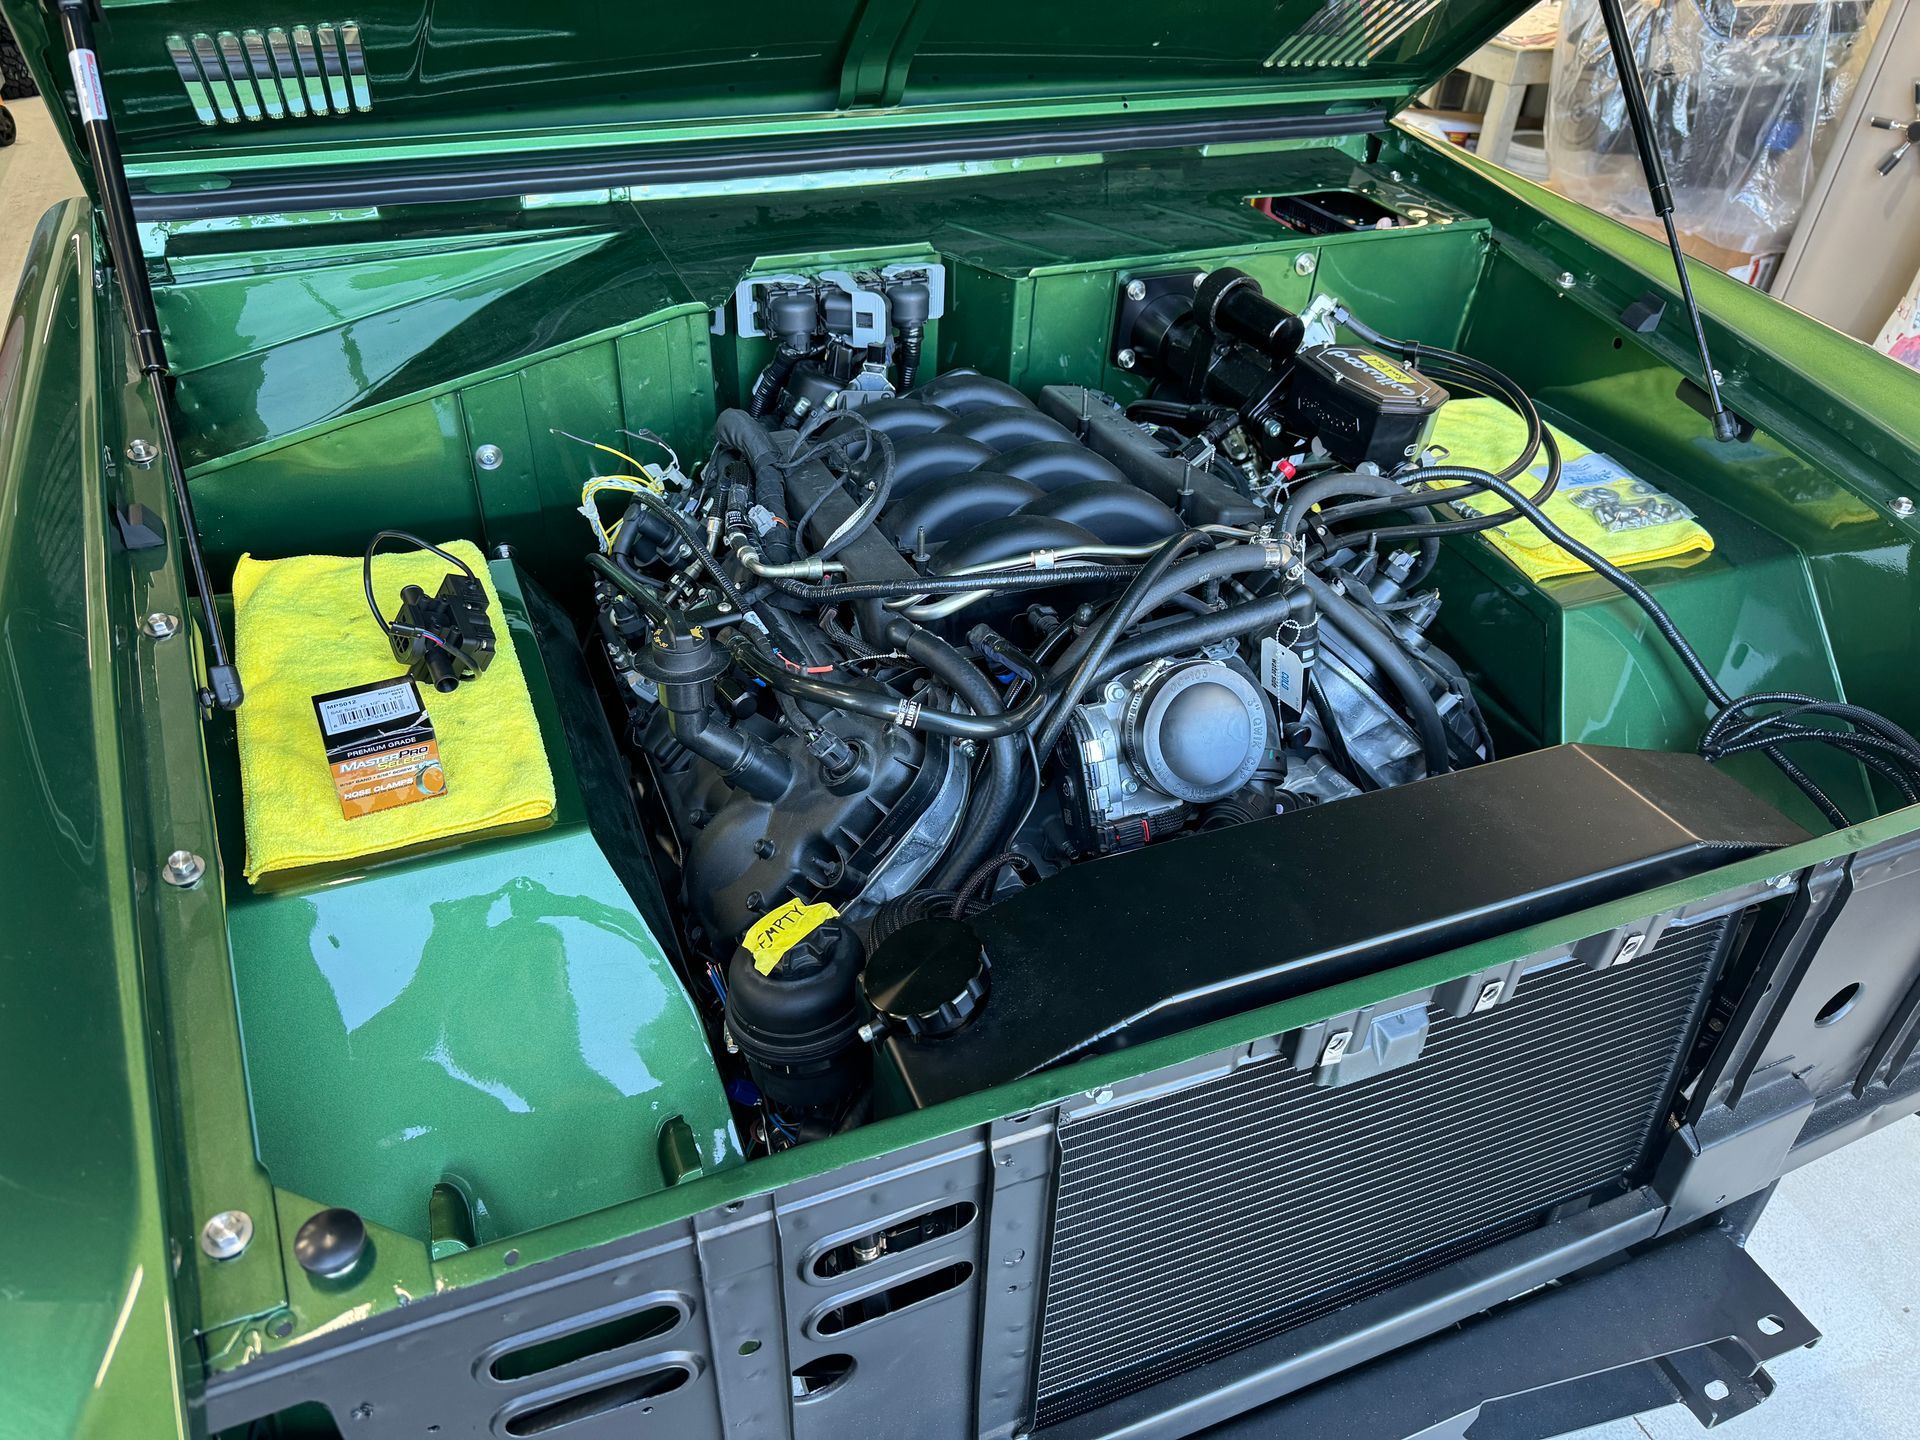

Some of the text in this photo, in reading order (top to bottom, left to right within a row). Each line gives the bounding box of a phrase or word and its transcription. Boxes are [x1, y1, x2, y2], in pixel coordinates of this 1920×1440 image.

[1327, 350, 1415, 395] wilwood
[1281, 671, 1289, 690] COLD
[327, 700, 356, 709] MP5012
[1252, 717, 1263, 749] QWIK
[347, 737, 416, 758] PREMIUM GRADE
[1240, 757, 1257, 779] CAP
[344, 788, 371, 800] HOSE
[374, 777, 414, 793] CLAMPS
[757, 905, 804, 949] EMPTY
